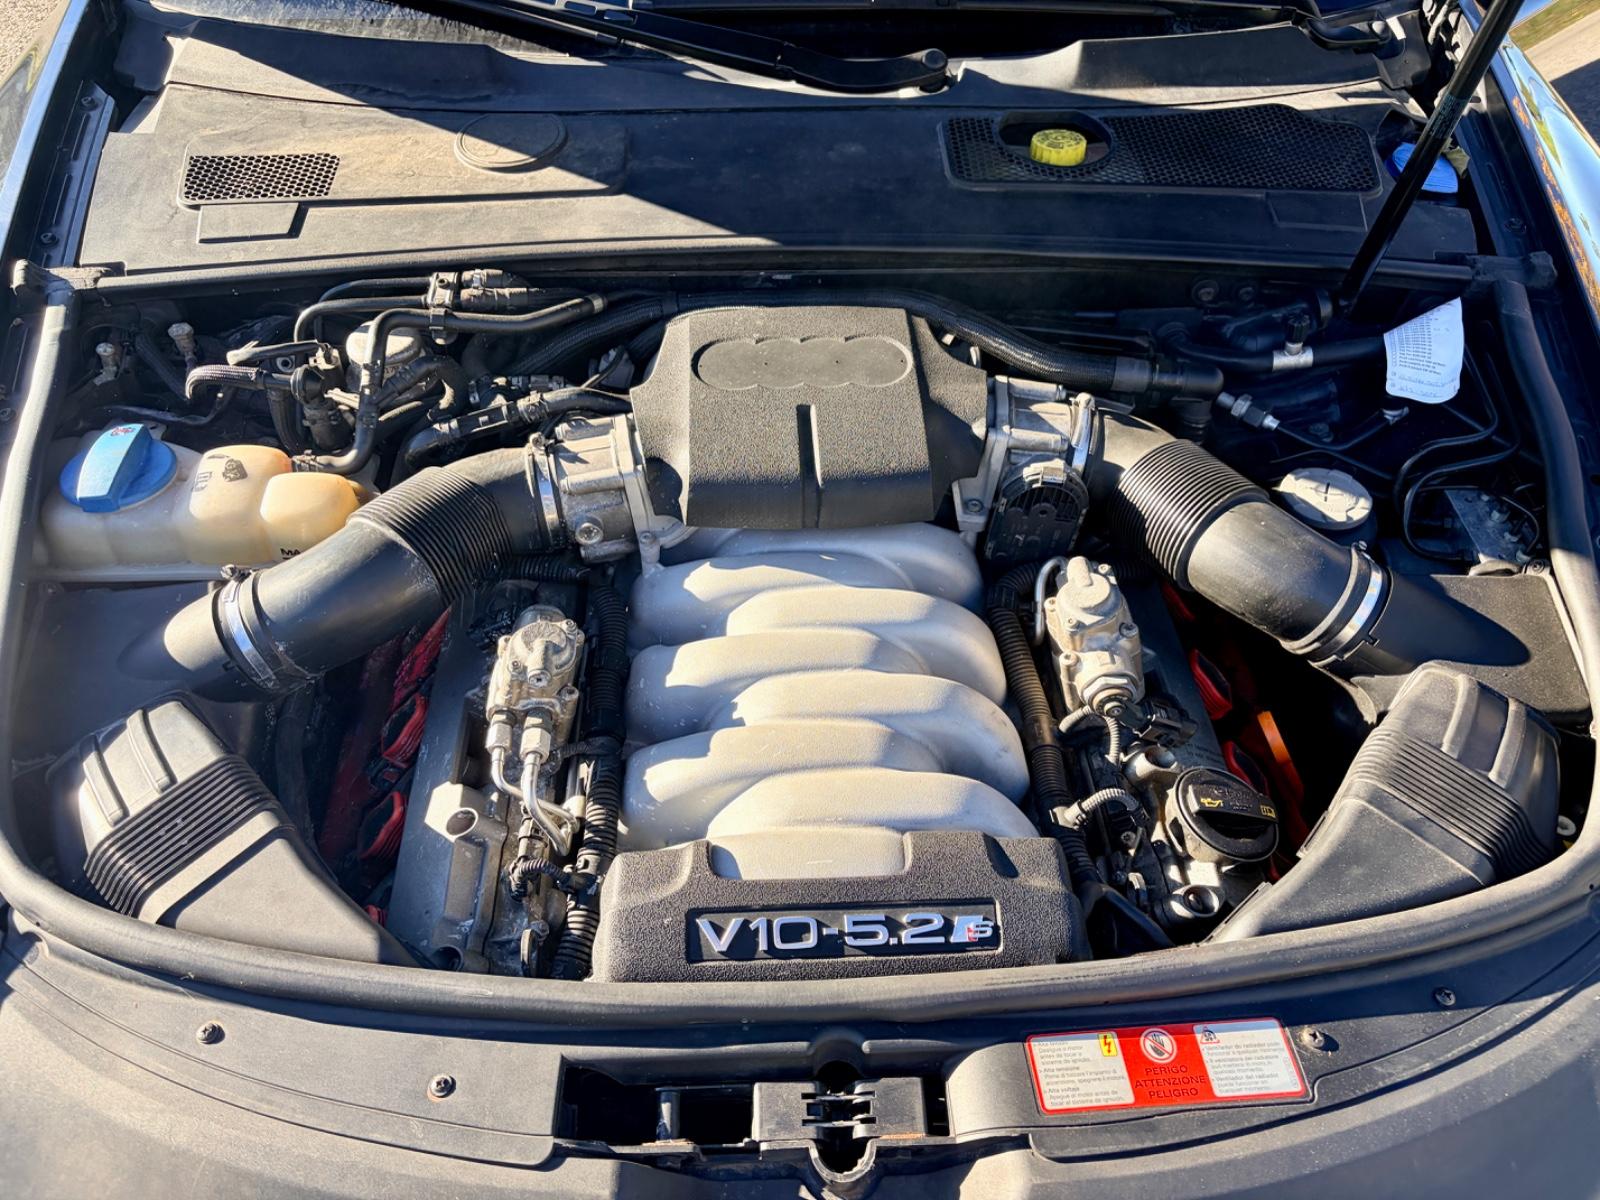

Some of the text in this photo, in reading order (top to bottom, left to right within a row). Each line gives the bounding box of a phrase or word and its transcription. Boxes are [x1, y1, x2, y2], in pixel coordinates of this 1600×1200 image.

[280, 547, 303, 556] MA
[1145, 1065, 1188, 1076] PERIGO
[1135, 1075, 1207, 1088] ATTENZIONE
[1148, 1087, 1199, 1099] PELIGRO
